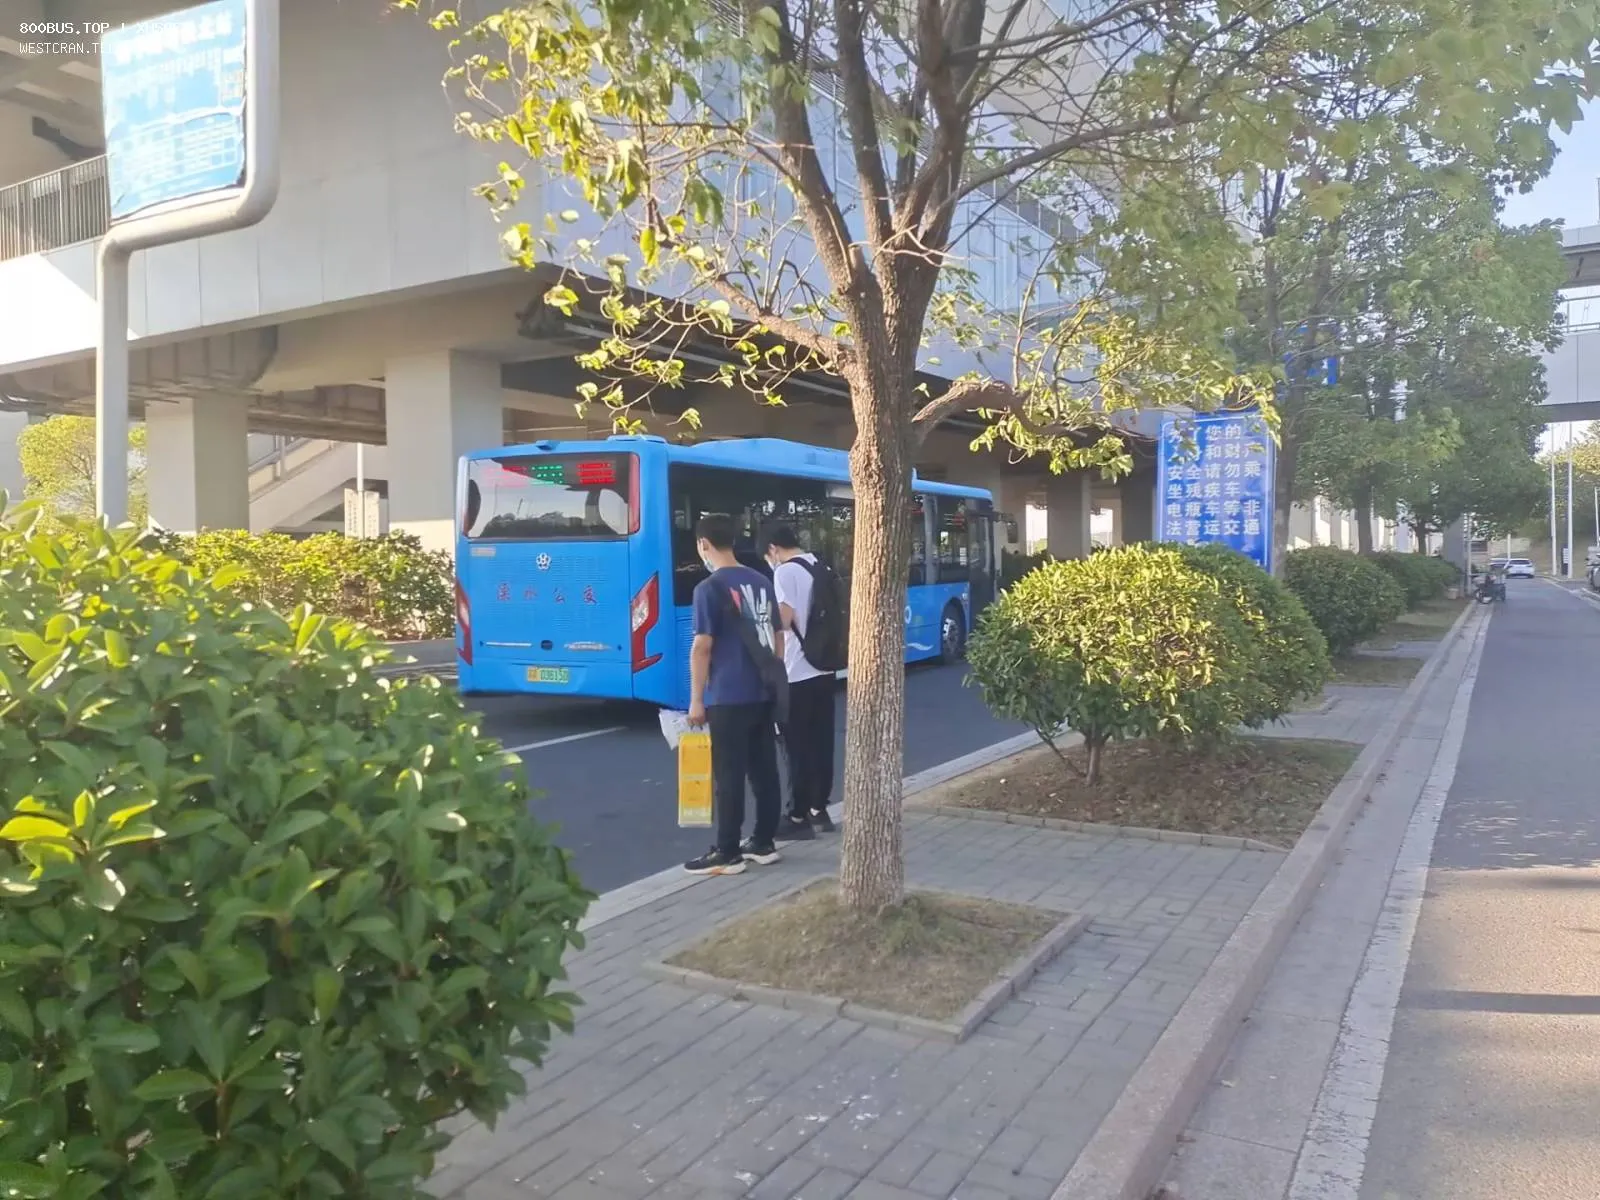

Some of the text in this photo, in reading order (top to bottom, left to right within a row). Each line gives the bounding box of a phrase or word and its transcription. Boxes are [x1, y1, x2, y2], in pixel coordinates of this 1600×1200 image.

[1167, 460, 1261, 481] 安全请勿乘
[1166, 518, 1261, 537] 法营运交通
